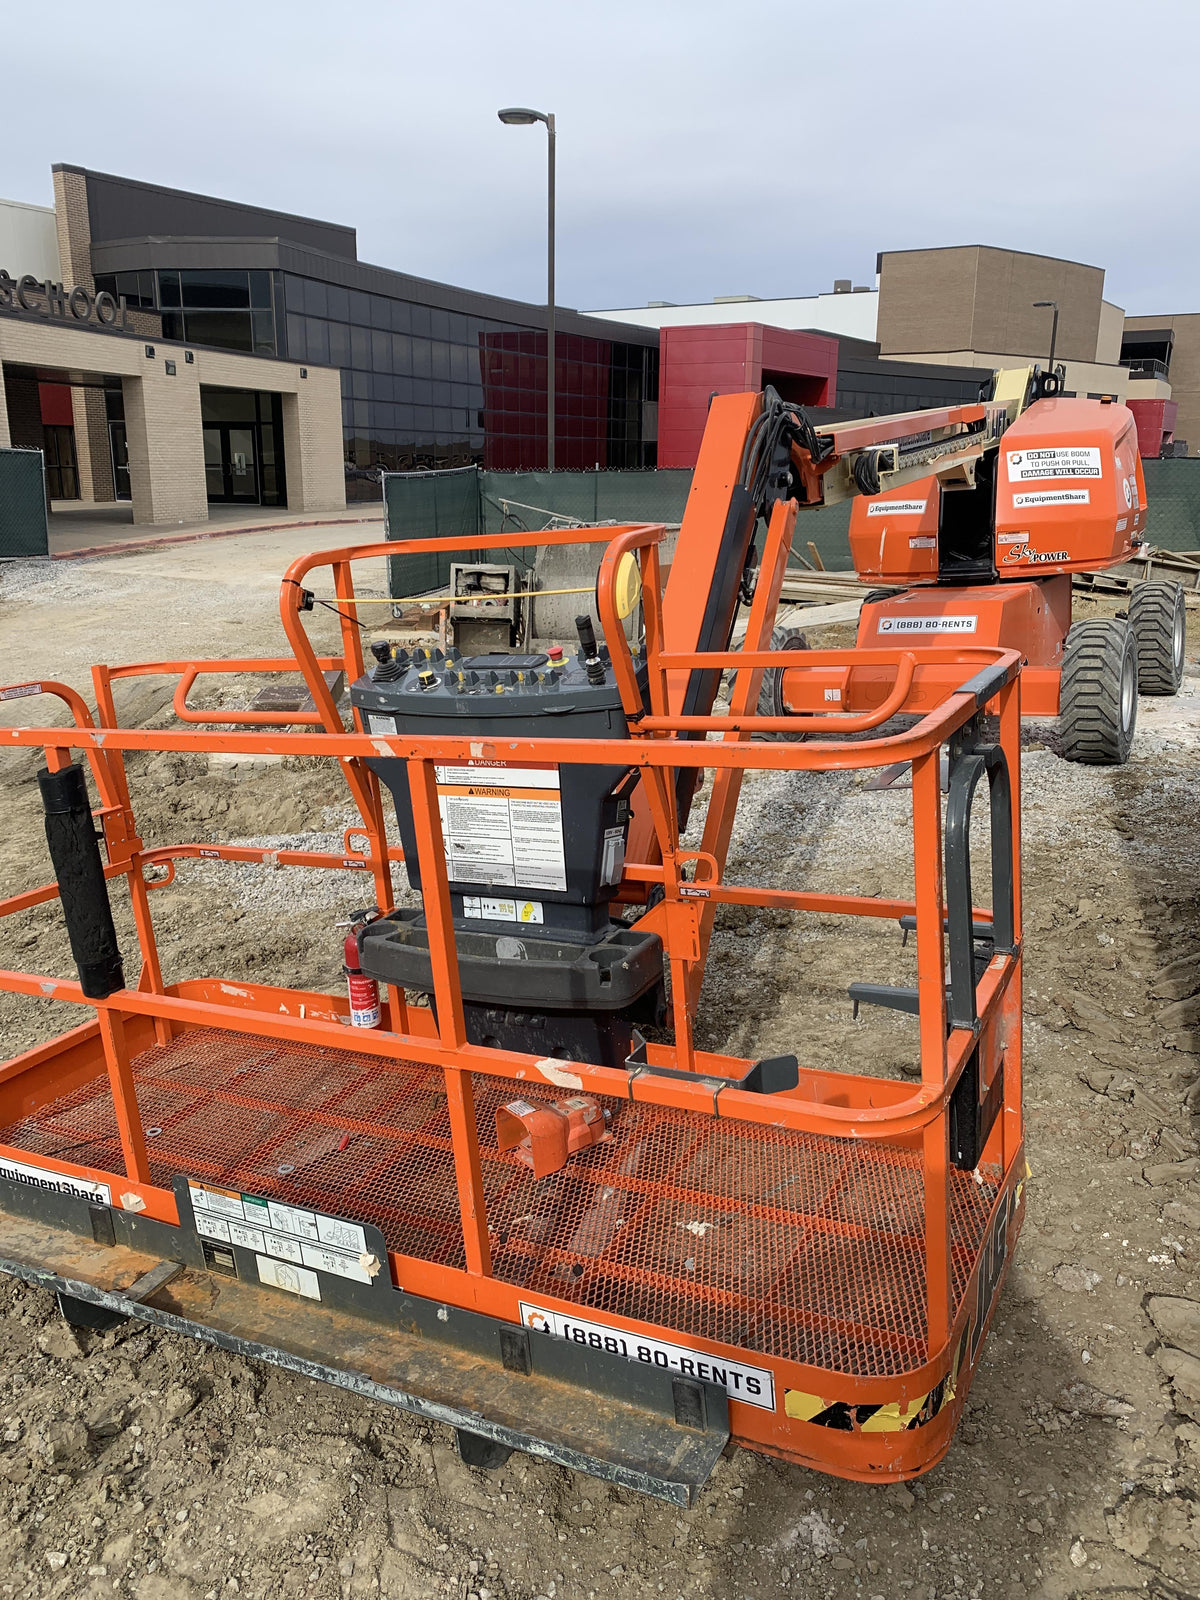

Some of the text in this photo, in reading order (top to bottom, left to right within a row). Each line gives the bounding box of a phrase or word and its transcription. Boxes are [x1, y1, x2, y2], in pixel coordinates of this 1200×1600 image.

[0, 269, 134, 331] SCHOOL
[1040, 451, 1055, 459] NOT
[1022, 469, 1055, 478] DAMAGE
[1074, 467, 1099, 475] OCCUR
[1024, 493, 1086, 503] EquipmentShare
[875, 503, 923, 512] EquipmentShare
[896, 620, 973, 629] (888) 80-RENTS
[474, 788, 511, 797] WARNING
[0, 1167, 104, 1205] quipmentShare
[563, 1323, 762, 1395] (888) 80-RENTS
